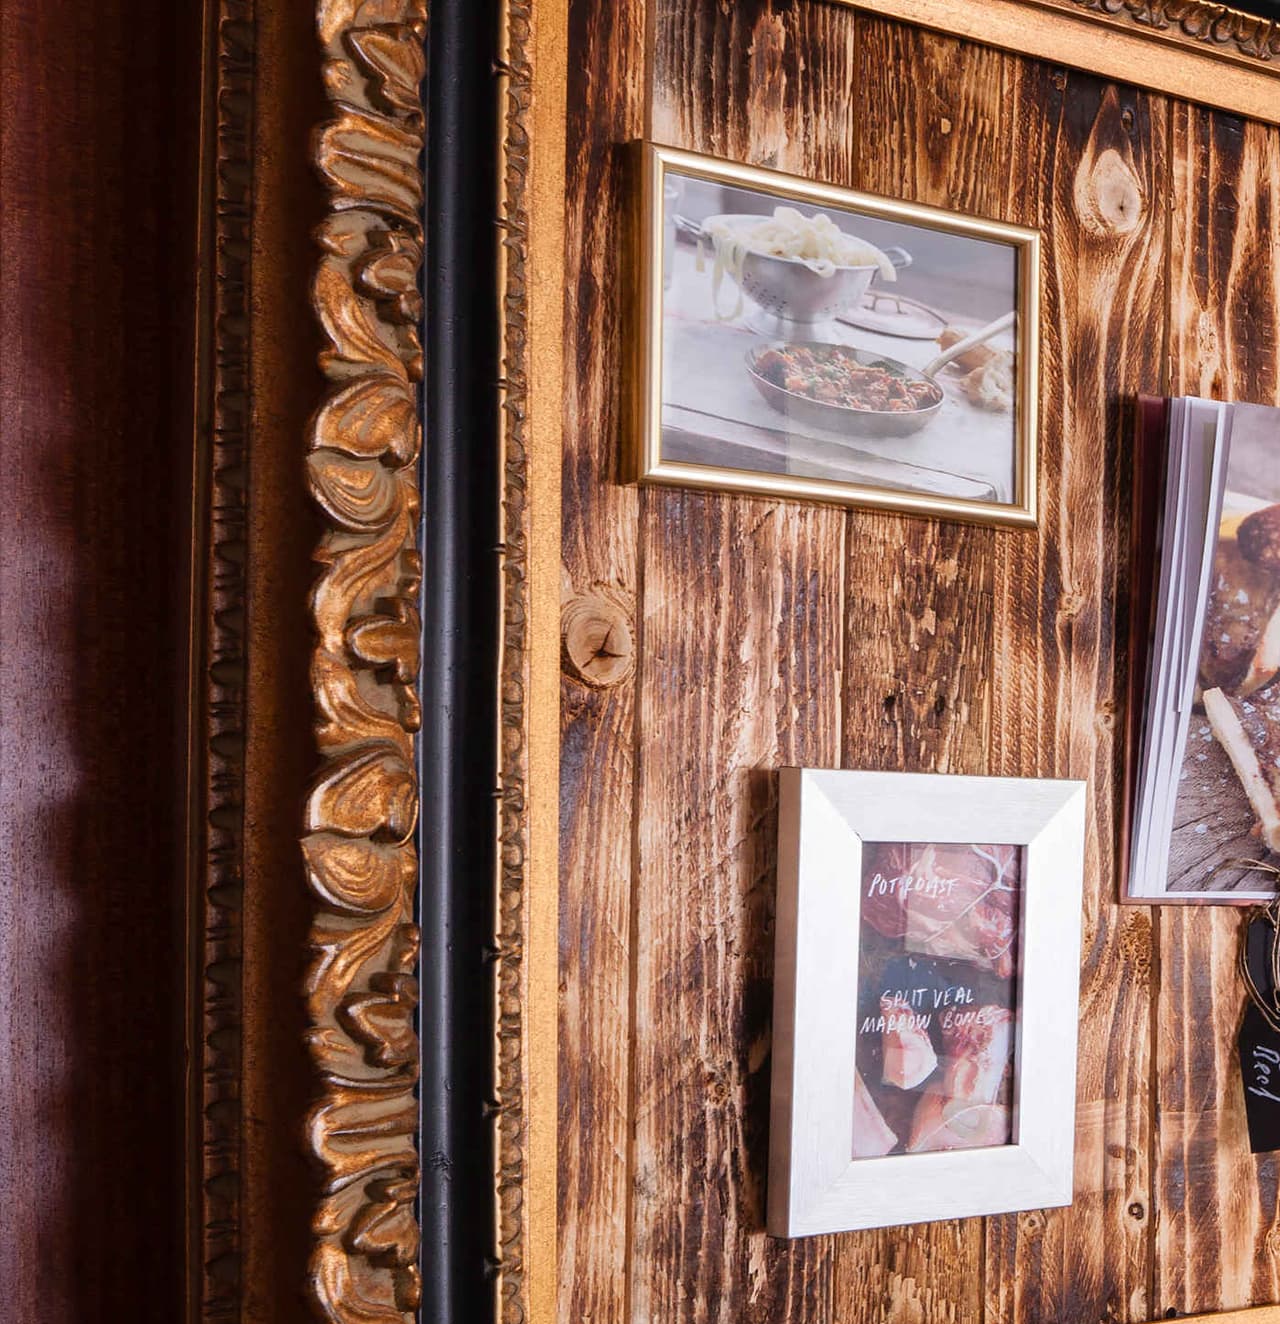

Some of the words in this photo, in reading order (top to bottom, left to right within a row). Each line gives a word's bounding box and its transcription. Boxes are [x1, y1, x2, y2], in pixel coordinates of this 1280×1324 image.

[880, 987, 924, 1009] SPLIT
[933, 987, 974, 1009] VEAL
[860, 1015, 931, 1034] MARROW
